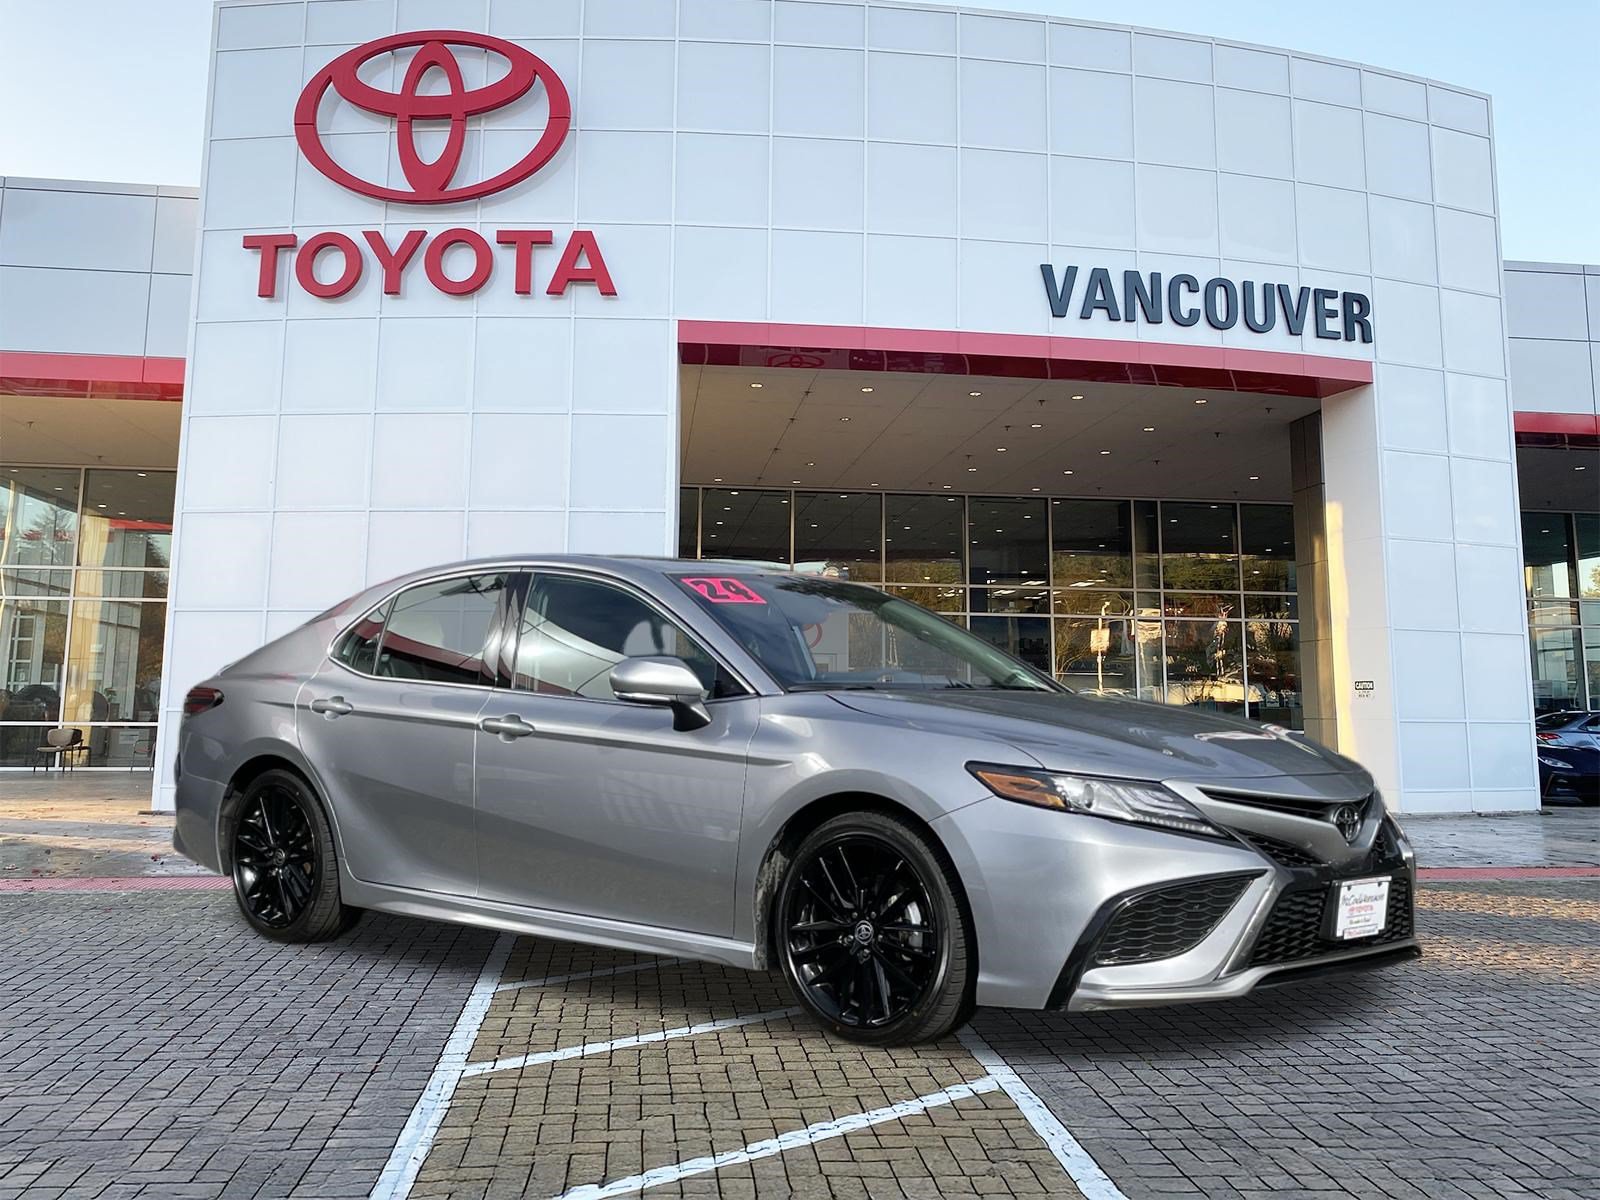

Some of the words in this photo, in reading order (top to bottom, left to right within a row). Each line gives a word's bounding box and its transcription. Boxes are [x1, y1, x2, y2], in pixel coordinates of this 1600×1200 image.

[243, 228, 617, 299] TOYOTA
[1040, 264, 1373, 344] VANCOUVER
[690, 580, 754, 600] 24
